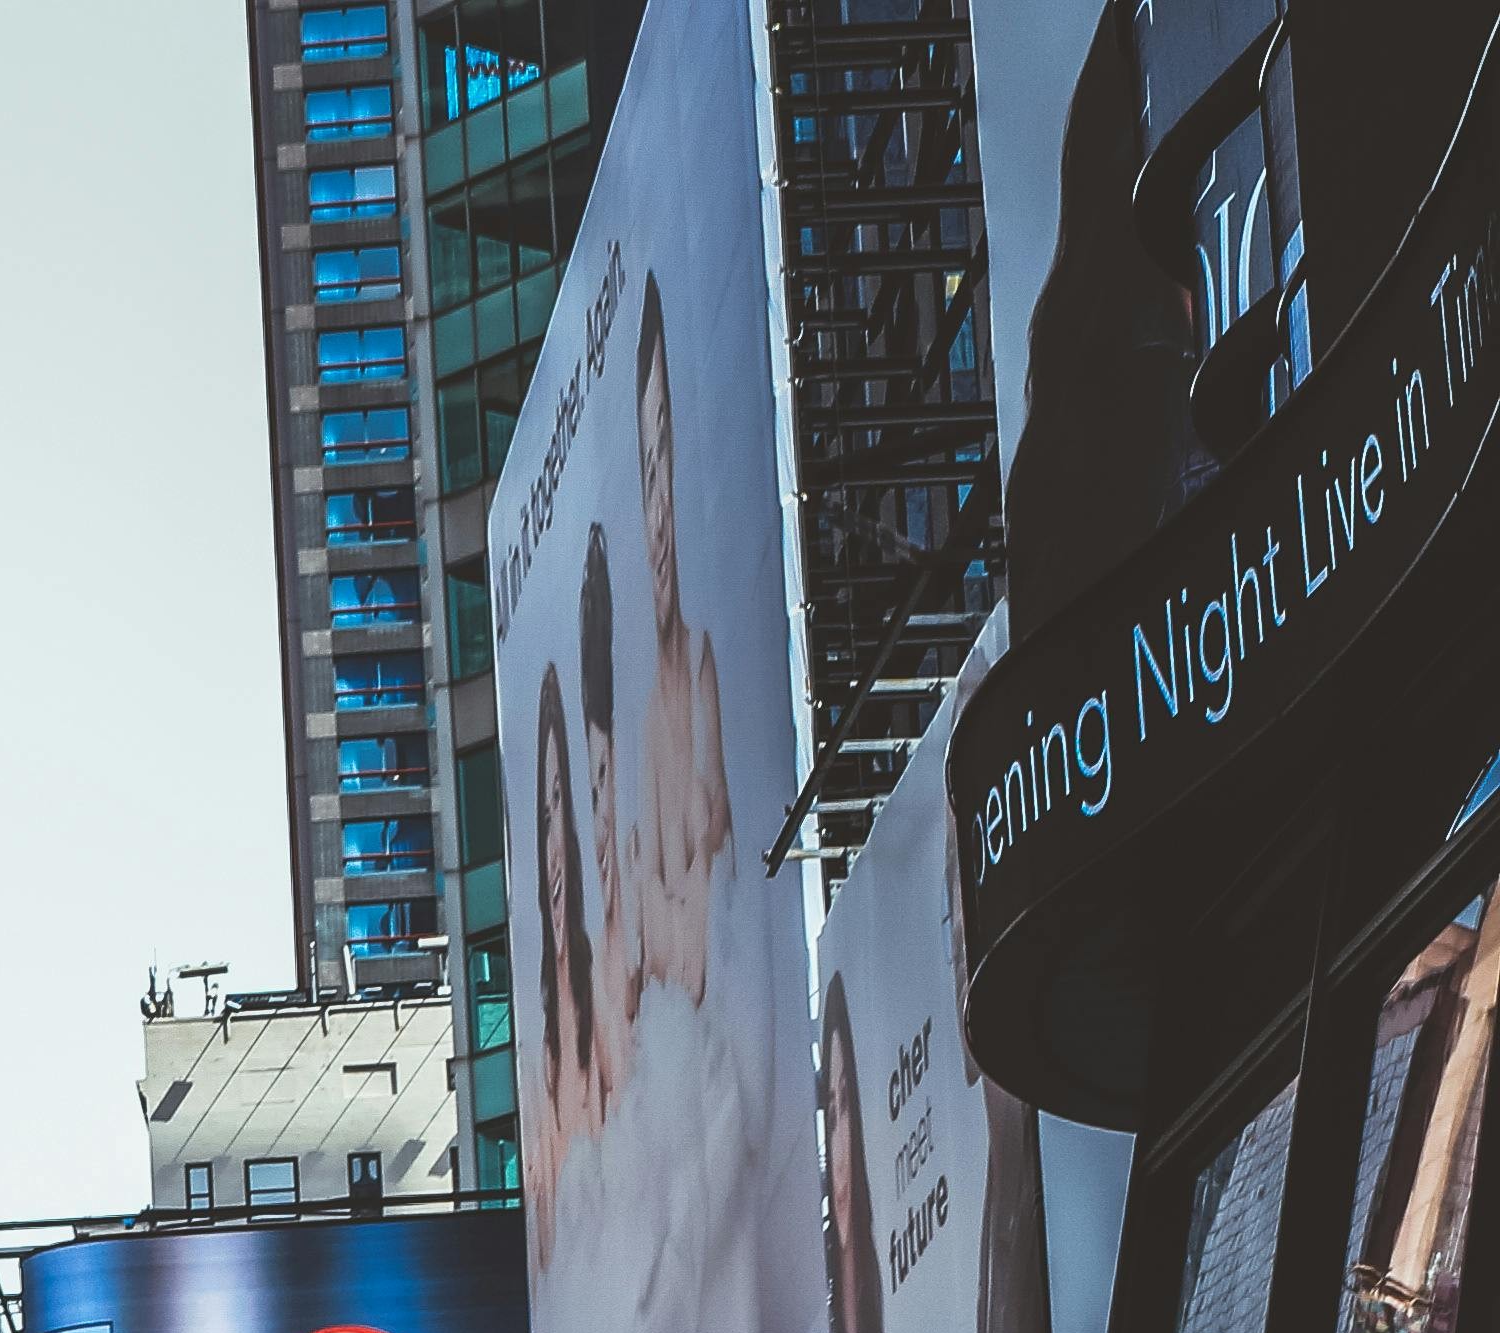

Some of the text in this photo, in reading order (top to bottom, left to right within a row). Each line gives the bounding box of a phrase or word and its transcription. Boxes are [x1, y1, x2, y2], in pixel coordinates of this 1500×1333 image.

[1133, 525, 1287, 726] Night
[1298, 452, 1385, 598] Live
[1392, 359, 1429, 482] in
[889, 1016, 933, 1124] cher
[895, 1104, 935, 1192] meet
[889, 1173, 949, 1294] future
